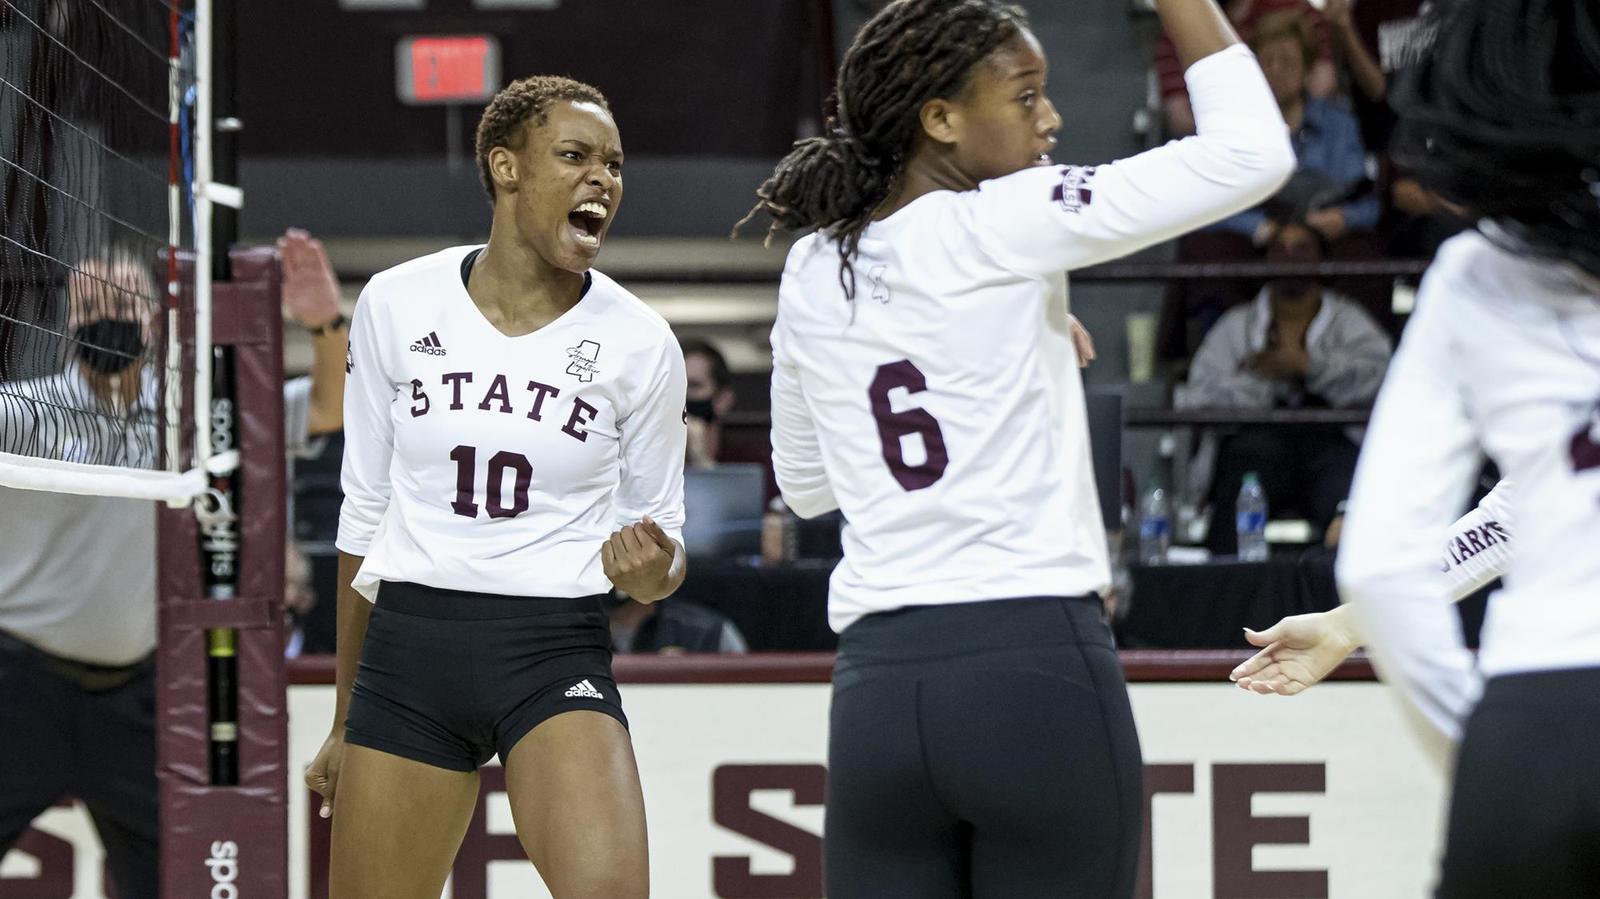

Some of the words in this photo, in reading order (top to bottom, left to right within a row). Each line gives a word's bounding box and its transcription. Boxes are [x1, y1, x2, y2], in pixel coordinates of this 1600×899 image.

[410, 344, 447, 357] adidas
[410, 372, 599, 442] STATE
[868, 359, 949, 492] 6
[450, 445, 533, 518] 10
[564, 688, 604, 700] adidas
